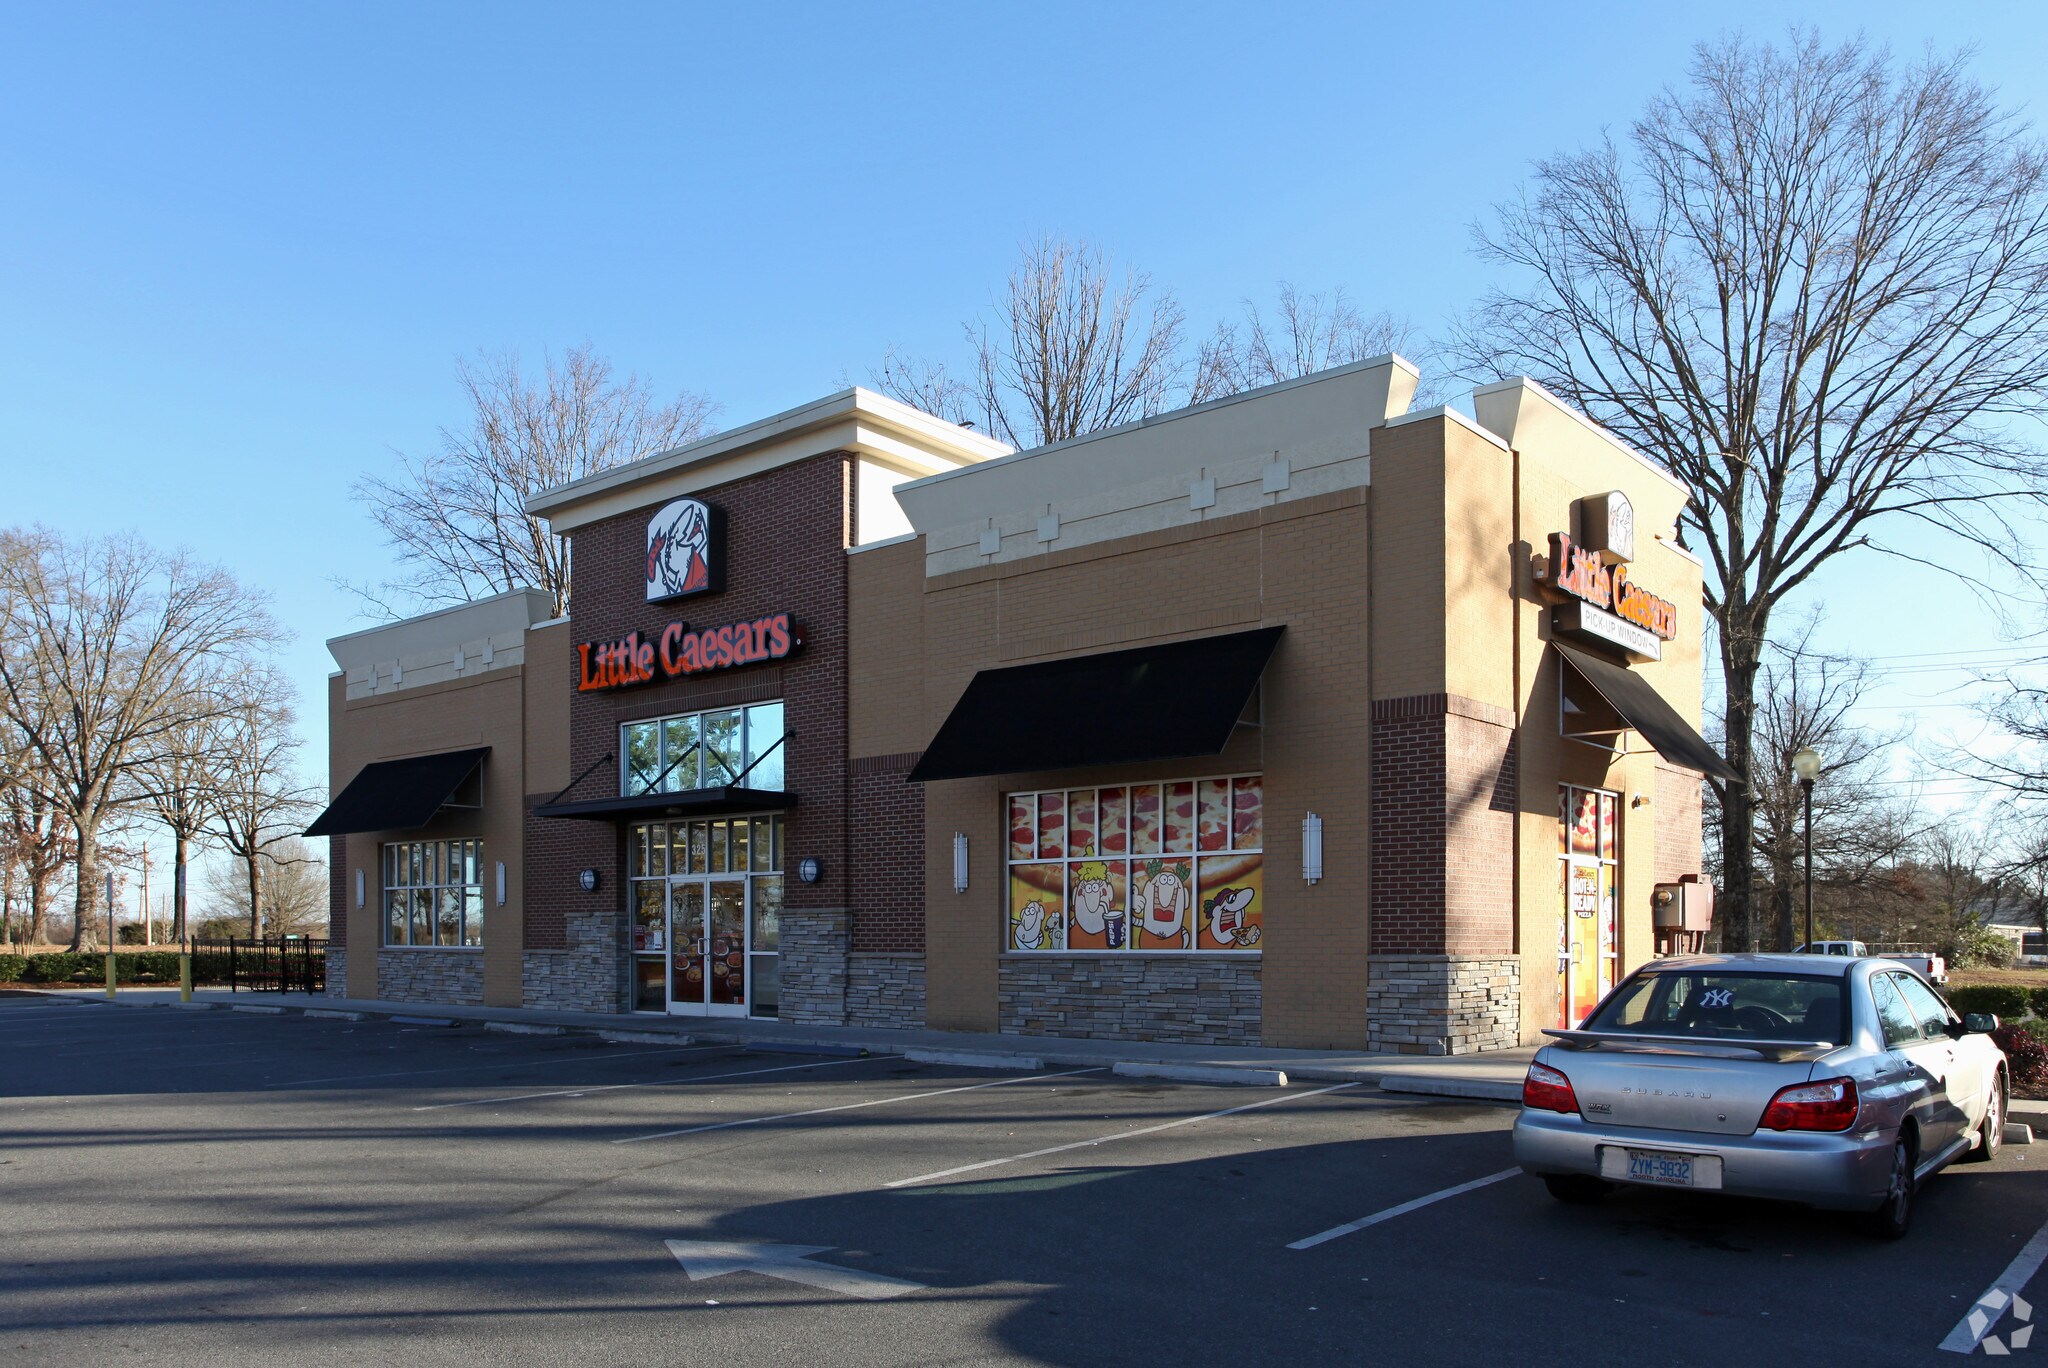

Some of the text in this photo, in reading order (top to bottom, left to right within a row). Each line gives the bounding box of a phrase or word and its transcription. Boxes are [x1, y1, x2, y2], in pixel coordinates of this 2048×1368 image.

[1557, 531, 1677, 641] Little Caesars
[1585, 609, 1649, 649] PICK-UP WINDOW
[576, 613, 791, 691] Little Caesars
[691, 844, 706, 856] 325
[1622, 1087, 1711, 1099] SUBARU
[1630, 1158, 1690, 1179] ZYM-9832
[1656, 1177, 1686, 1185] CAROLINA
